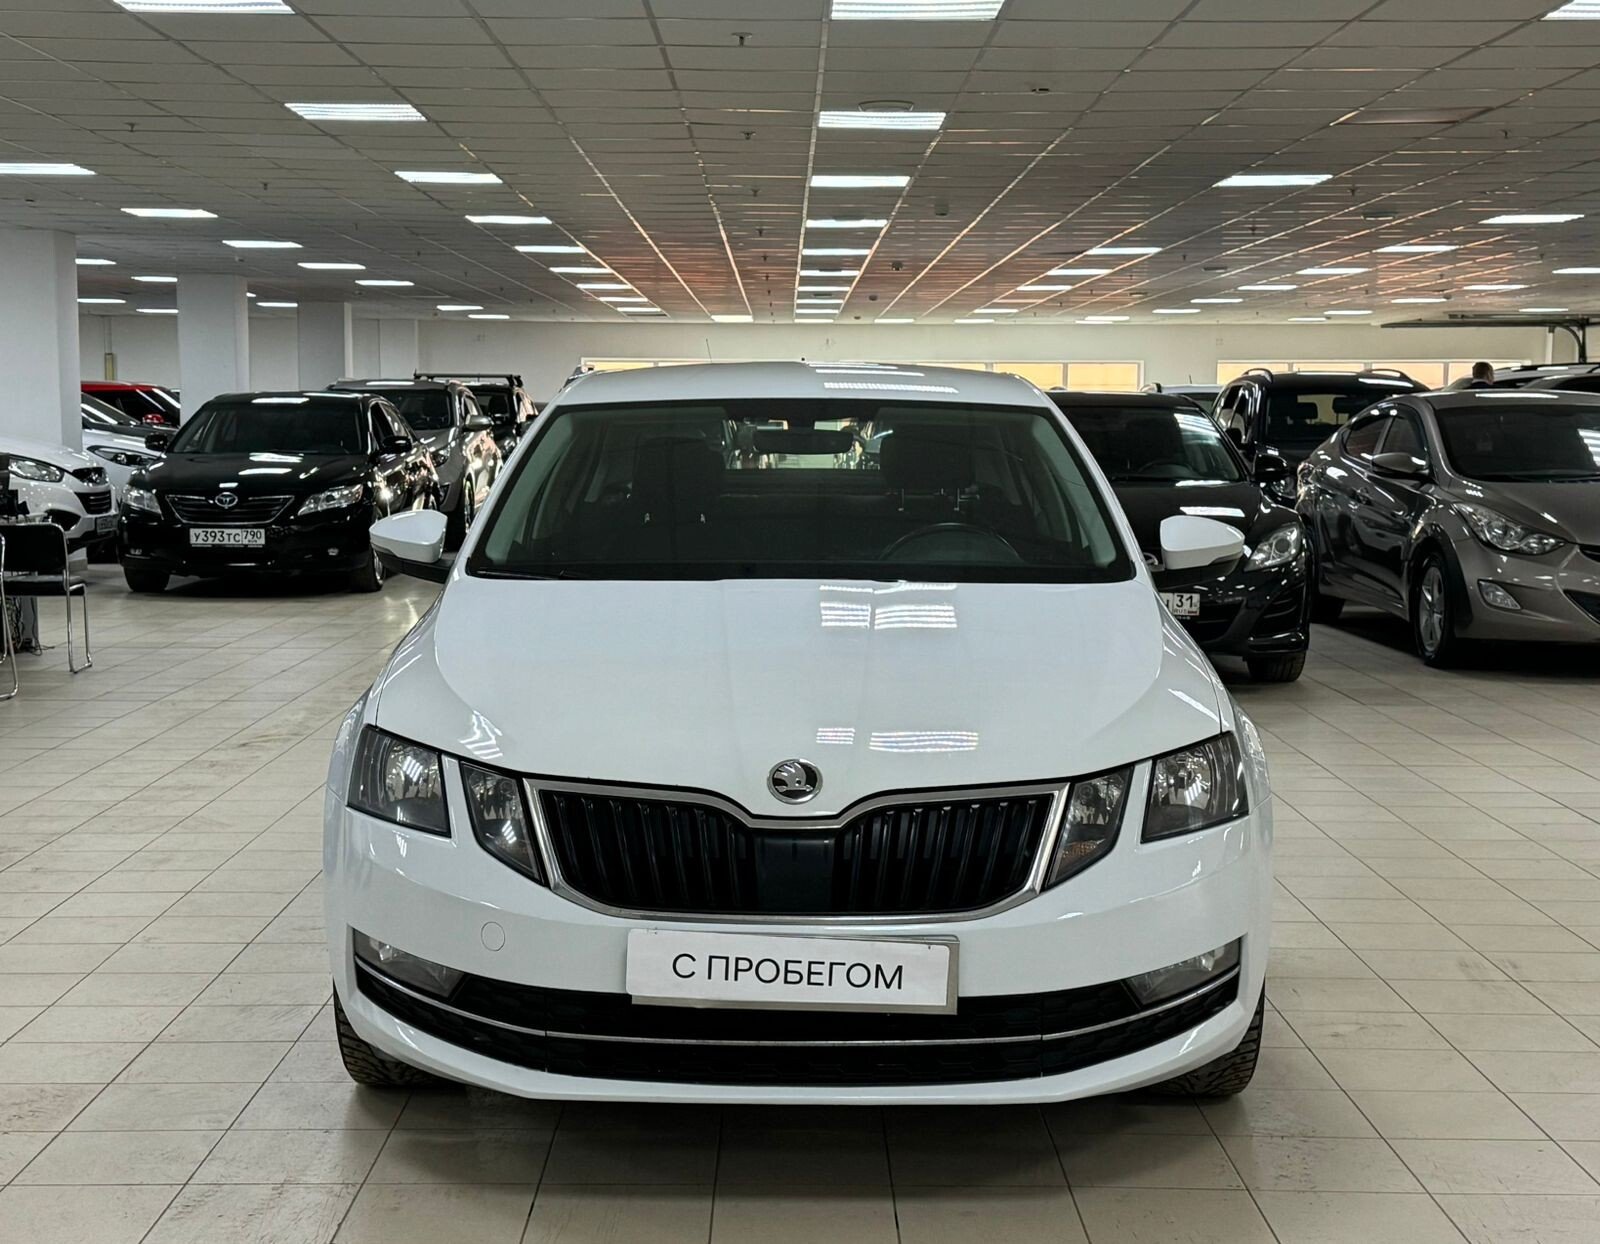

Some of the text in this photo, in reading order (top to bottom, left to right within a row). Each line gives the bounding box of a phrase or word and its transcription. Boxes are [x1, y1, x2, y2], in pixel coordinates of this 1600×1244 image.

[243, 530, 262, 540] 790
[671, 953, 904, 991] С ПРОБЕГОМ
